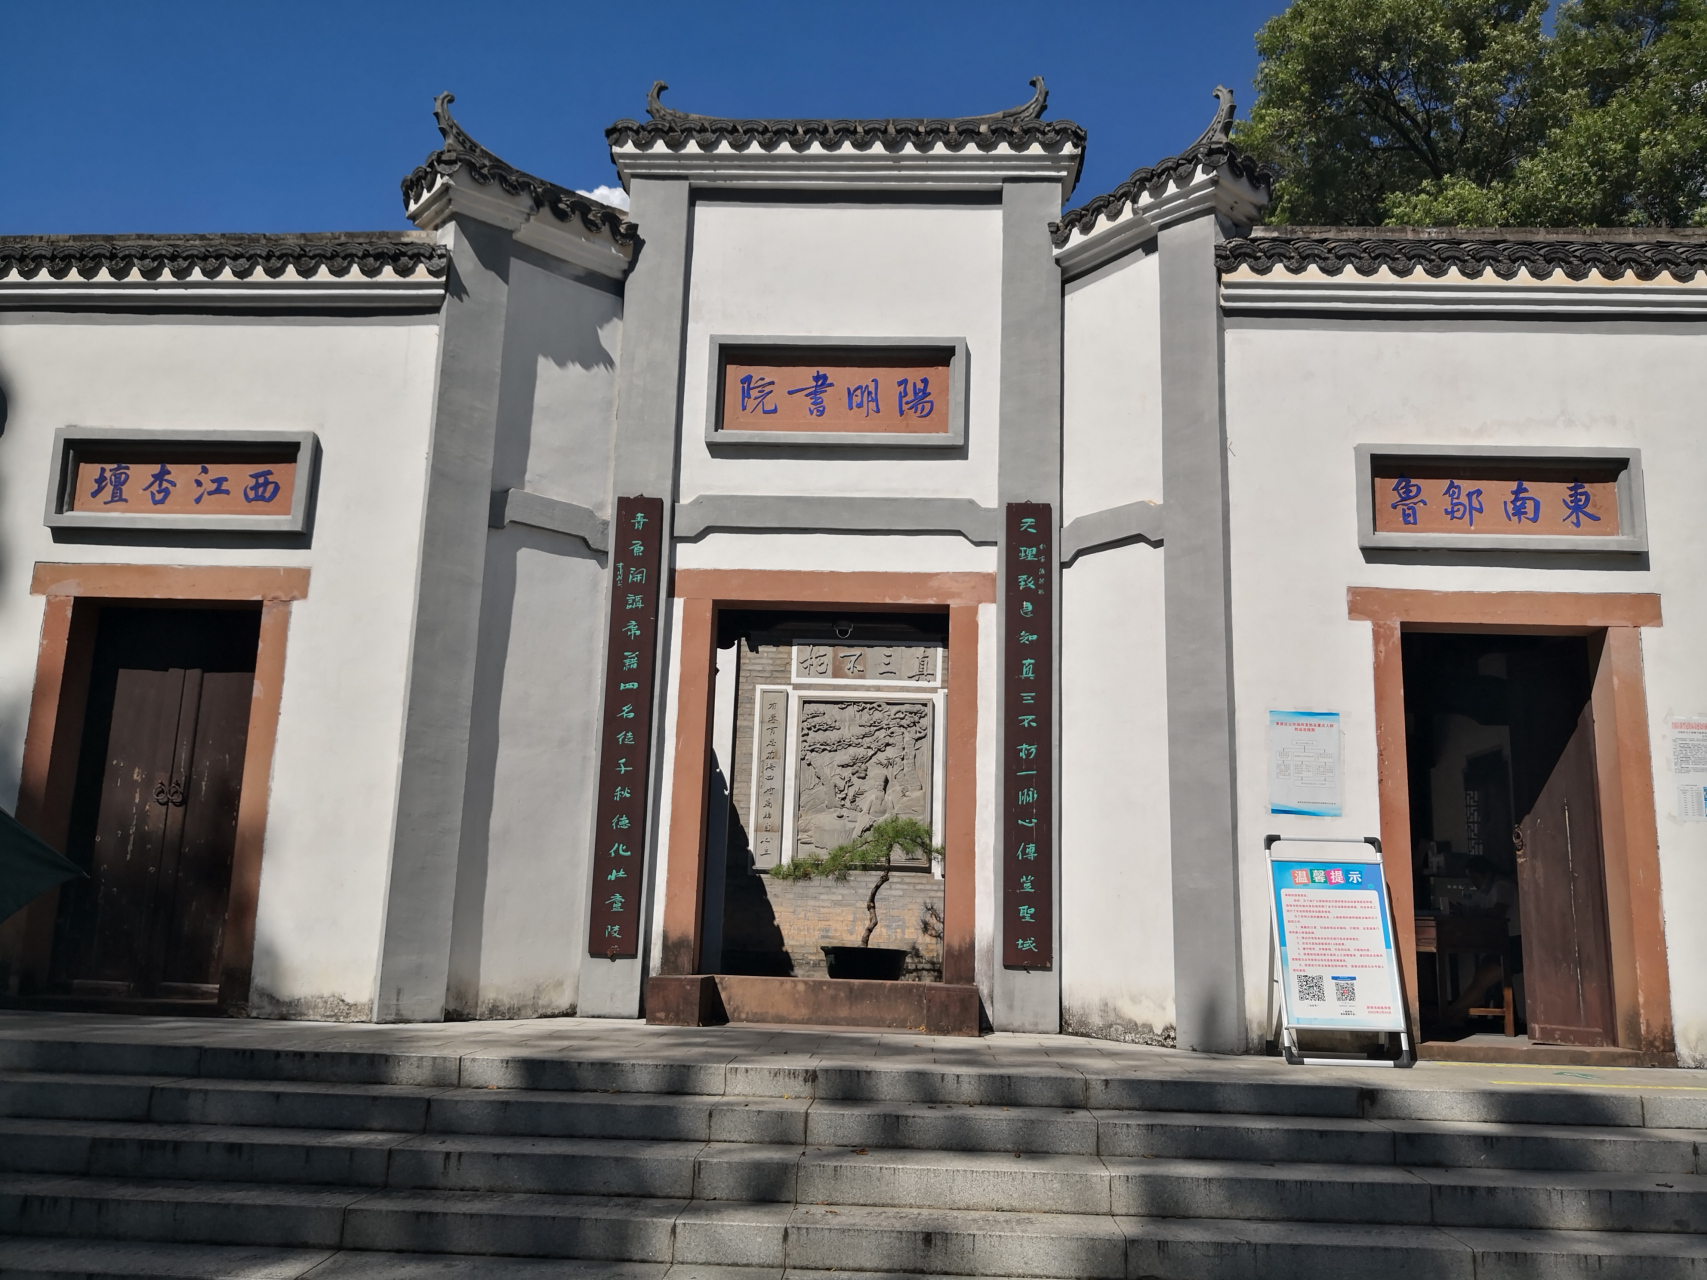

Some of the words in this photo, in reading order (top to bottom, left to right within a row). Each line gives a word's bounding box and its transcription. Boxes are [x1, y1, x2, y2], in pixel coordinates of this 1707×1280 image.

[740, 370, 934, 417] 陽明書院
[90, 463, 280, 505] 西江杏壇
[1390, 474, 1601, 528] 東南鄒魯
[1294, 869, 1363, 884] 温馨提示
